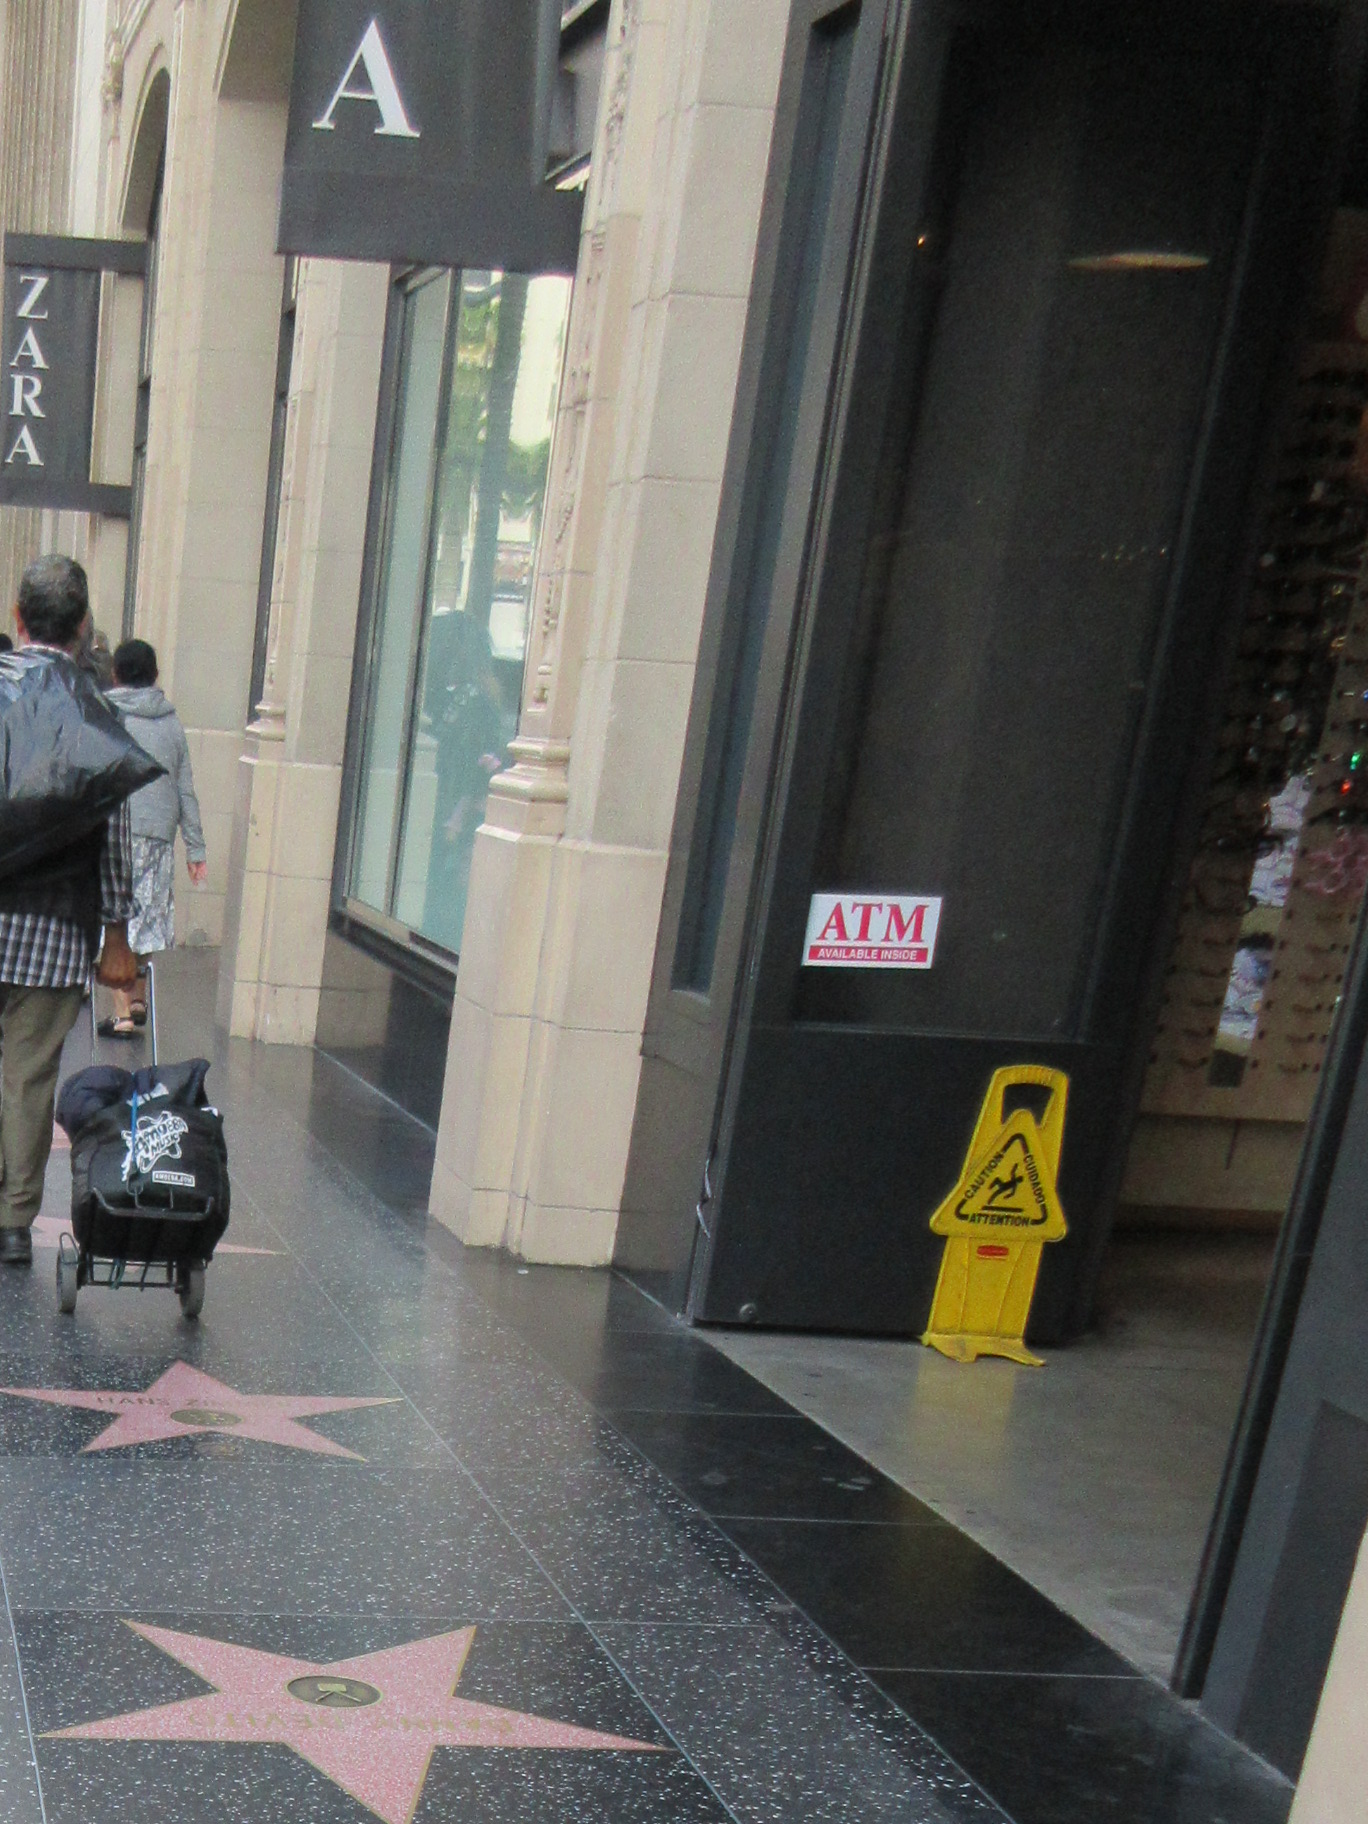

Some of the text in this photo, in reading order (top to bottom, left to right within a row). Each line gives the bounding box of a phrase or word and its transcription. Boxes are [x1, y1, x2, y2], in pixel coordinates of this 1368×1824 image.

[5, 276, 50, 466] ZARA
[816, 902, 930, 943] ATM
[817, 948, 918, 961] AVAILABLE INSIDE
[964, 1150, 1004, 1200] CAUTION
[1023, 1154, 1046, 1205] CUIDADO
[968, 1214, 1031, 1228] ATTENTION
[97, 1397, 170, 1406] HANS
